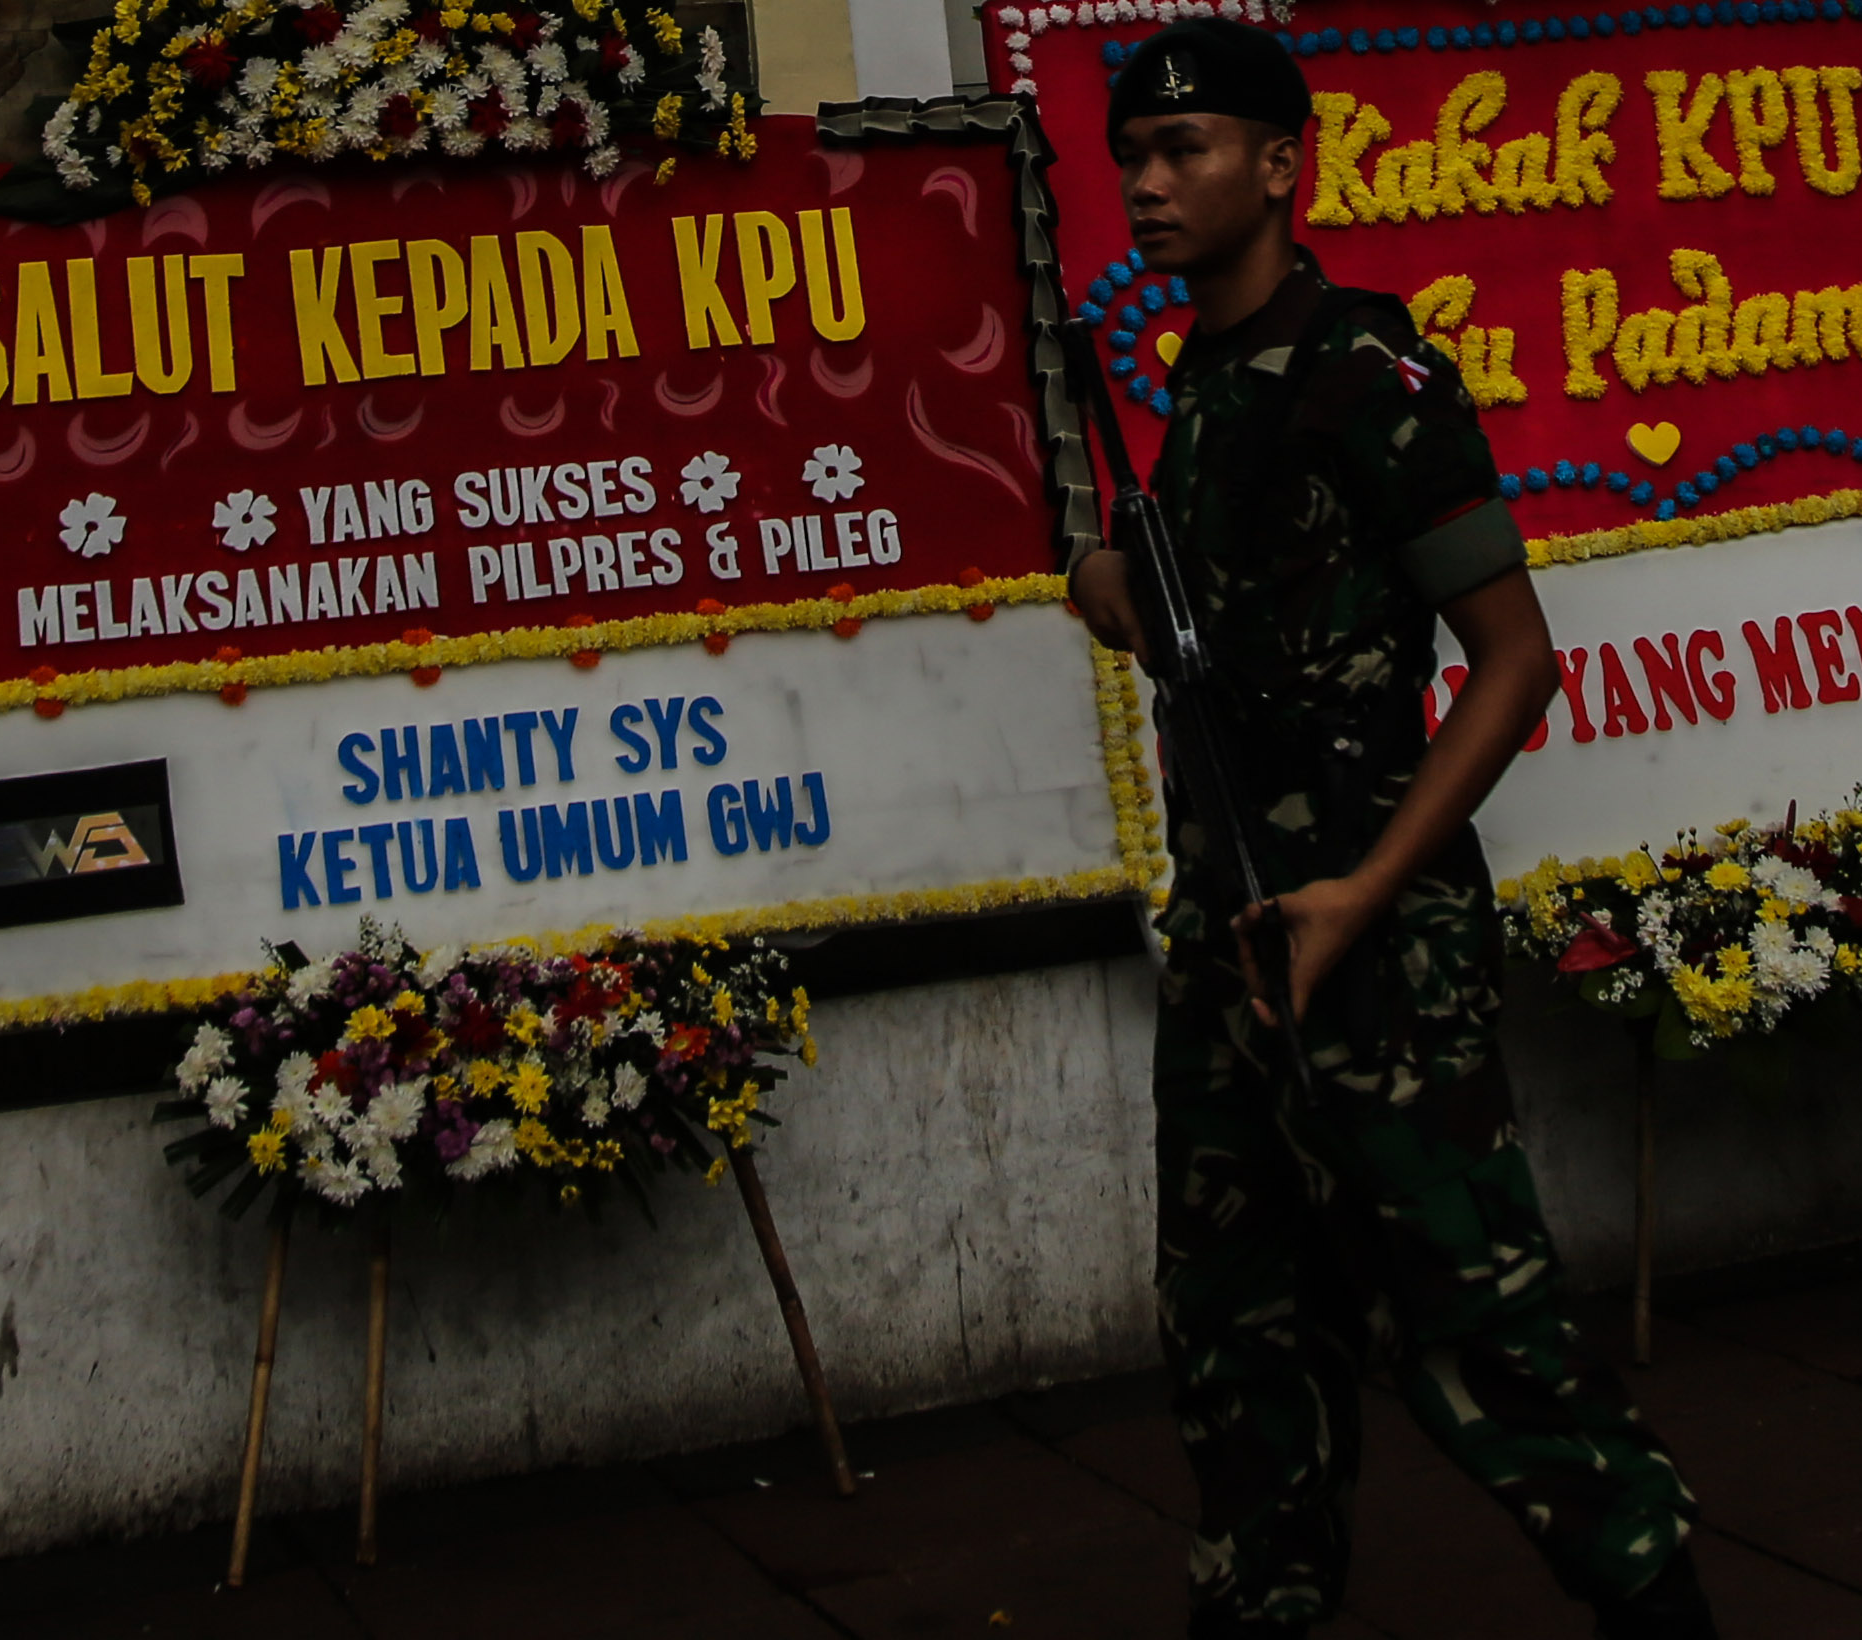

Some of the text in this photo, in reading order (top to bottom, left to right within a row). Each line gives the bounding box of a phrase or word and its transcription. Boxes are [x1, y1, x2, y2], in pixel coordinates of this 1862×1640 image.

[1305, 69, 1623, 227] Kakak
[289, 223, 640, 389] KEPADA
[670, 205, 868, 353] KPU
[297, 455, 658, 547] YANG SUKSES
[16, 508, 903, 648] MELAKSANAKAN PILPRES & PILEG
[336, 694, 729, 806] SHANTY SYS
[1553, 629, 1736, 744] YANG
[277, 770, 832, 910] KETUA UMUM GWJ
